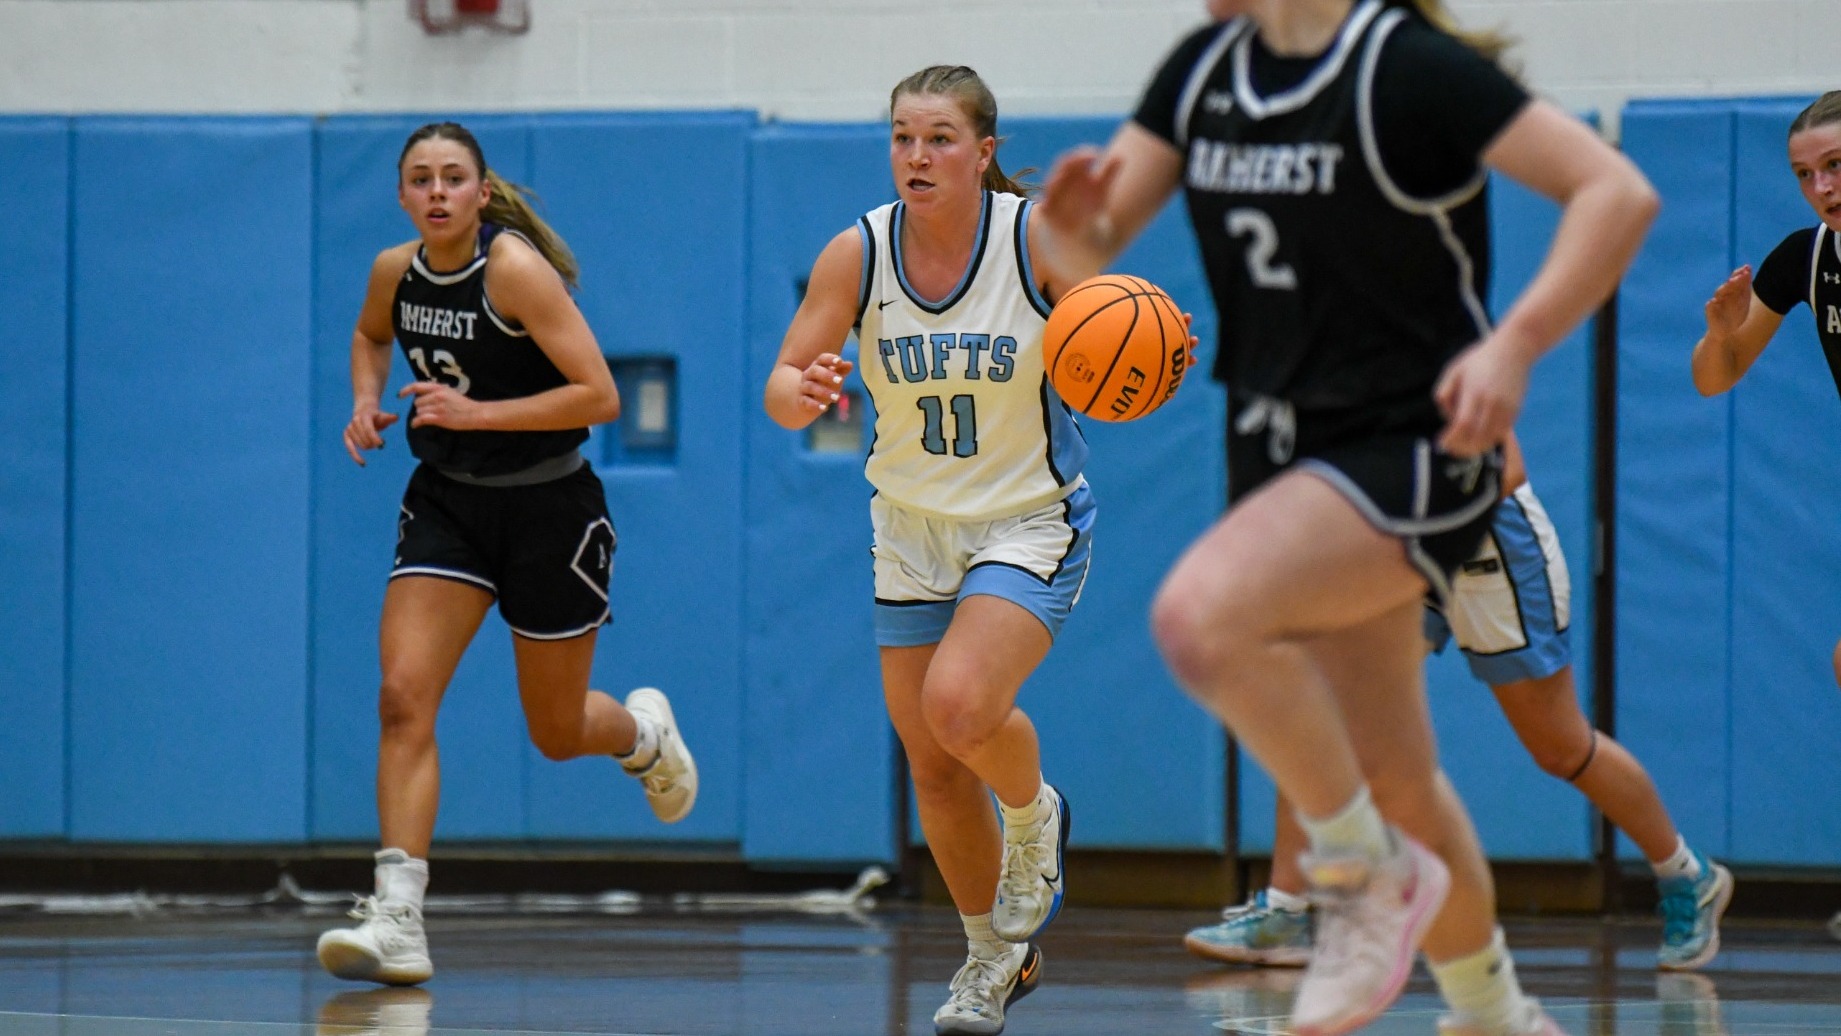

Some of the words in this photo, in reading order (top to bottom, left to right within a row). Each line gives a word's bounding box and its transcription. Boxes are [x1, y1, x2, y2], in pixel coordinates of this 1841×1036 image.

[1225, 208, 1297, 290] 2
[409, 347, 470, 395] 13
[878, 333, 1017, 384] TUFTS
[916, 394, 978, 458] 11
